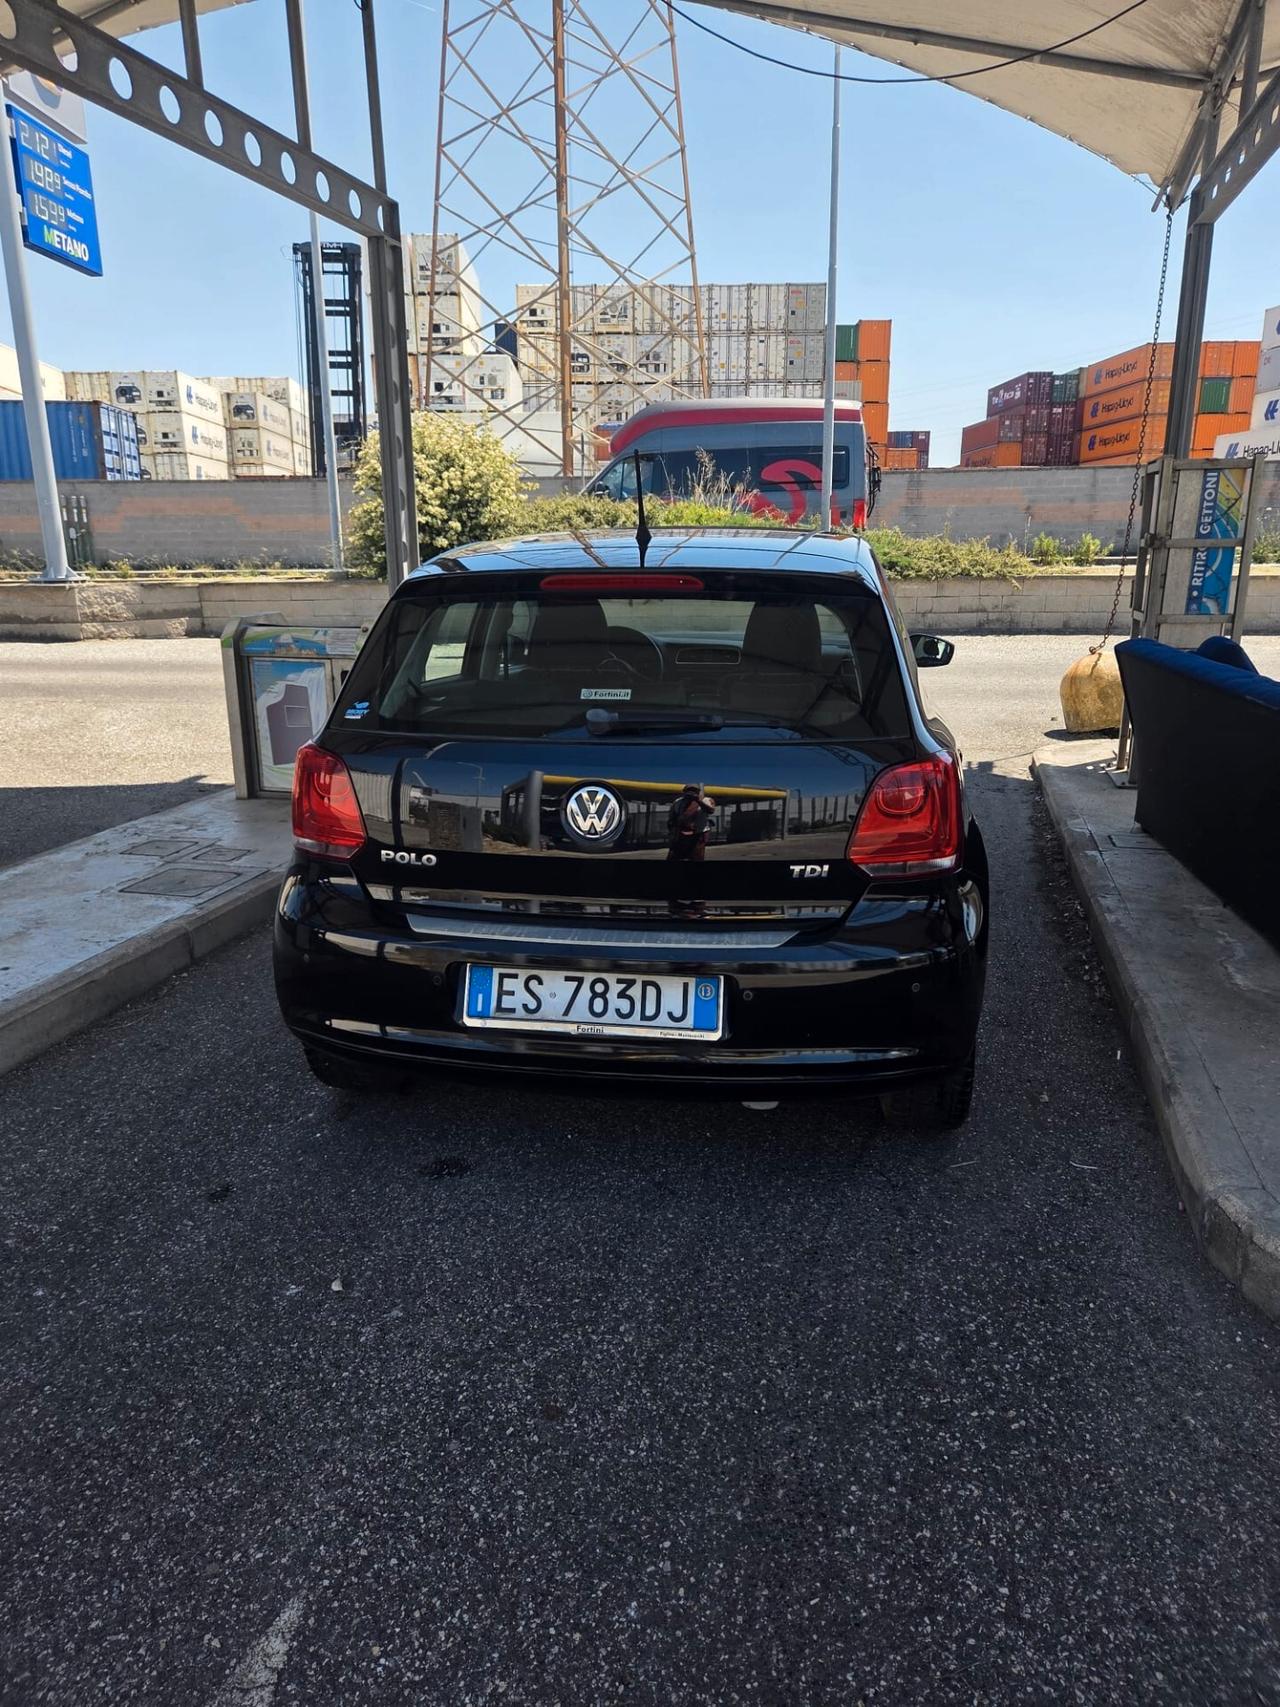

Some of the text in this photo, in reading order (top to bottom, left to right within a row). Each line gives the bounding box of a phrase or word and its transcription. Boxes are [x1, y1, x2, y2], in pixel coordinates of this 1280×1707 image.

[43, 225, 89, 262] METANO
[1098, 432, 1131, 448] Hapag-Lloyd
[1192, 472, 1219, 586] RITIR GETTONI
[380, 849, 437, 867] POLO
[789, 864, 829, 879] TDI
[494, 972, 544, 1015] ES
[562, 975, 689, 1024] 783DJ
[576, 1025, 605, 1034] Fortini
